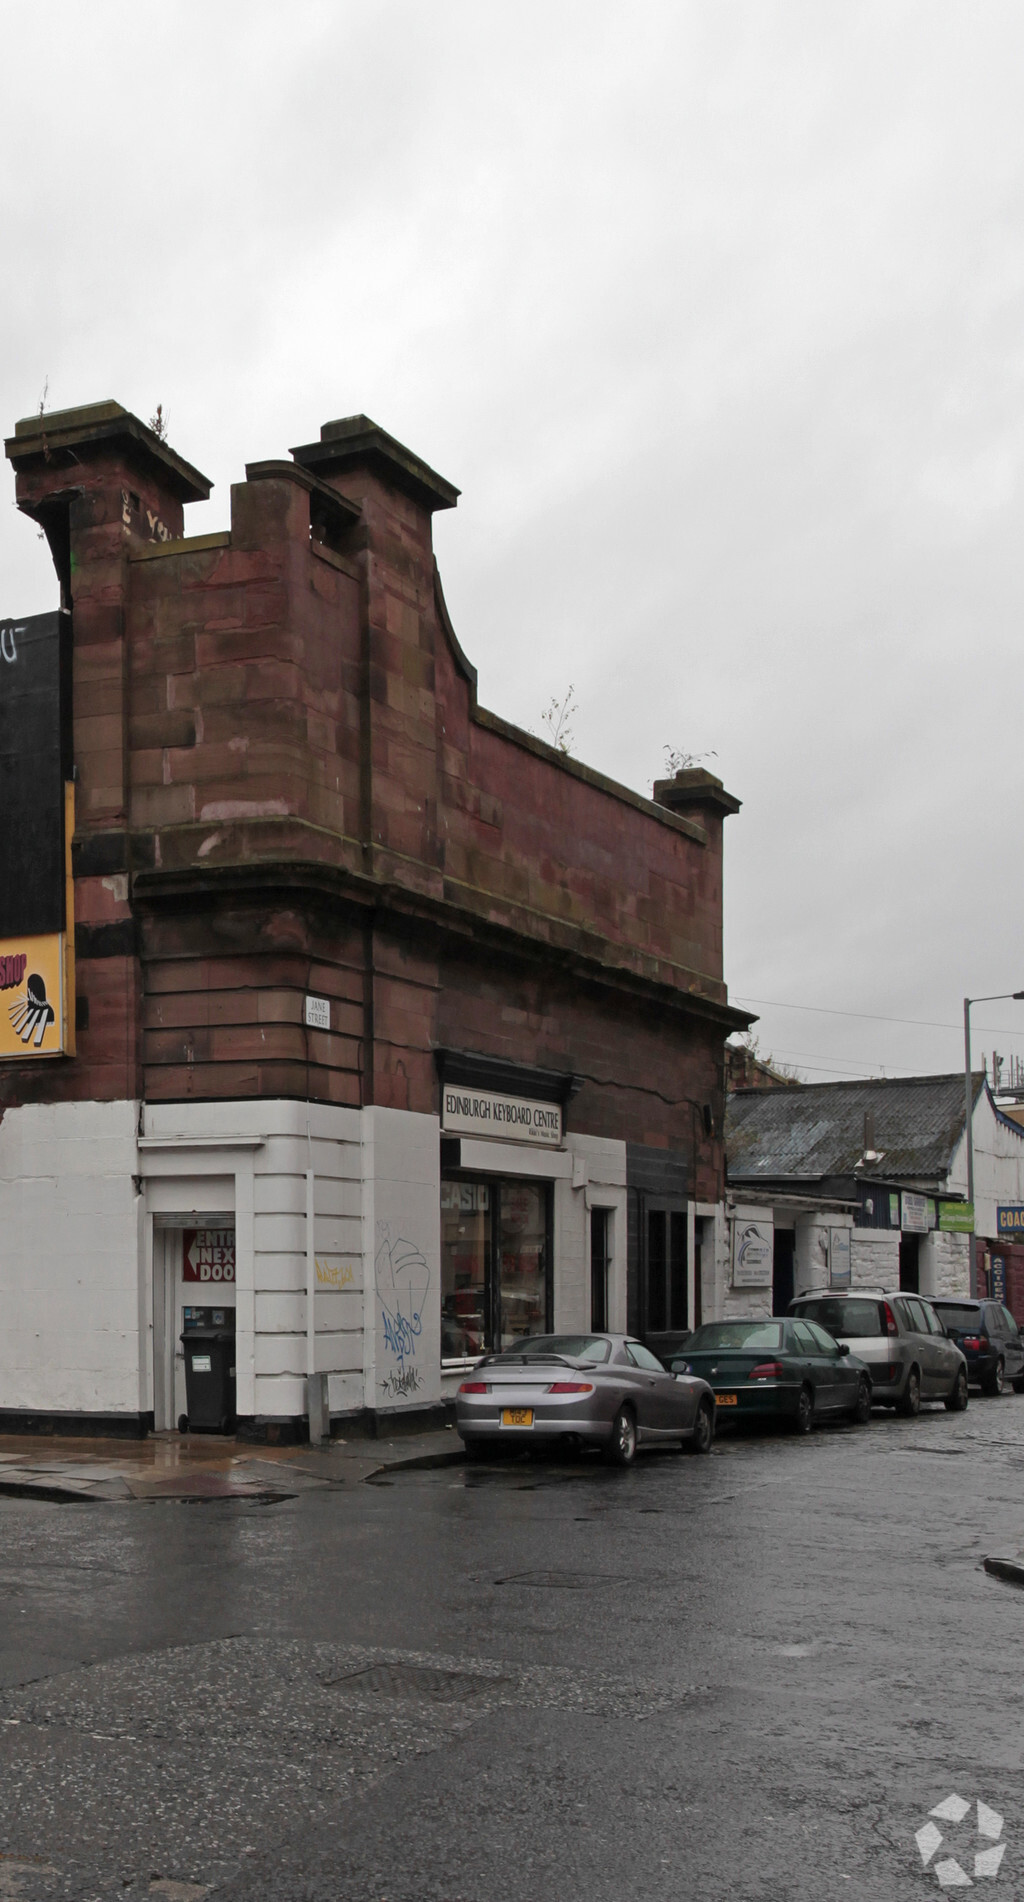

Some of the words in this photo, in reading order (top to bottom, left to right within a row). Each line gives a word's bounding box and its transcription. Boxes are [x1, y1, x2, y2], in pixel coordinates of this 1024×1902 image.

[311, 1000, 325, 1012] JANE
[308, 1012, 328, 1025] STREET
[446, 1094, 491, 1119] EDINBURGH
[493, 1102, 532, 1125] KEYBOARD
[533, 1109, 558, 1129] CENTRE
